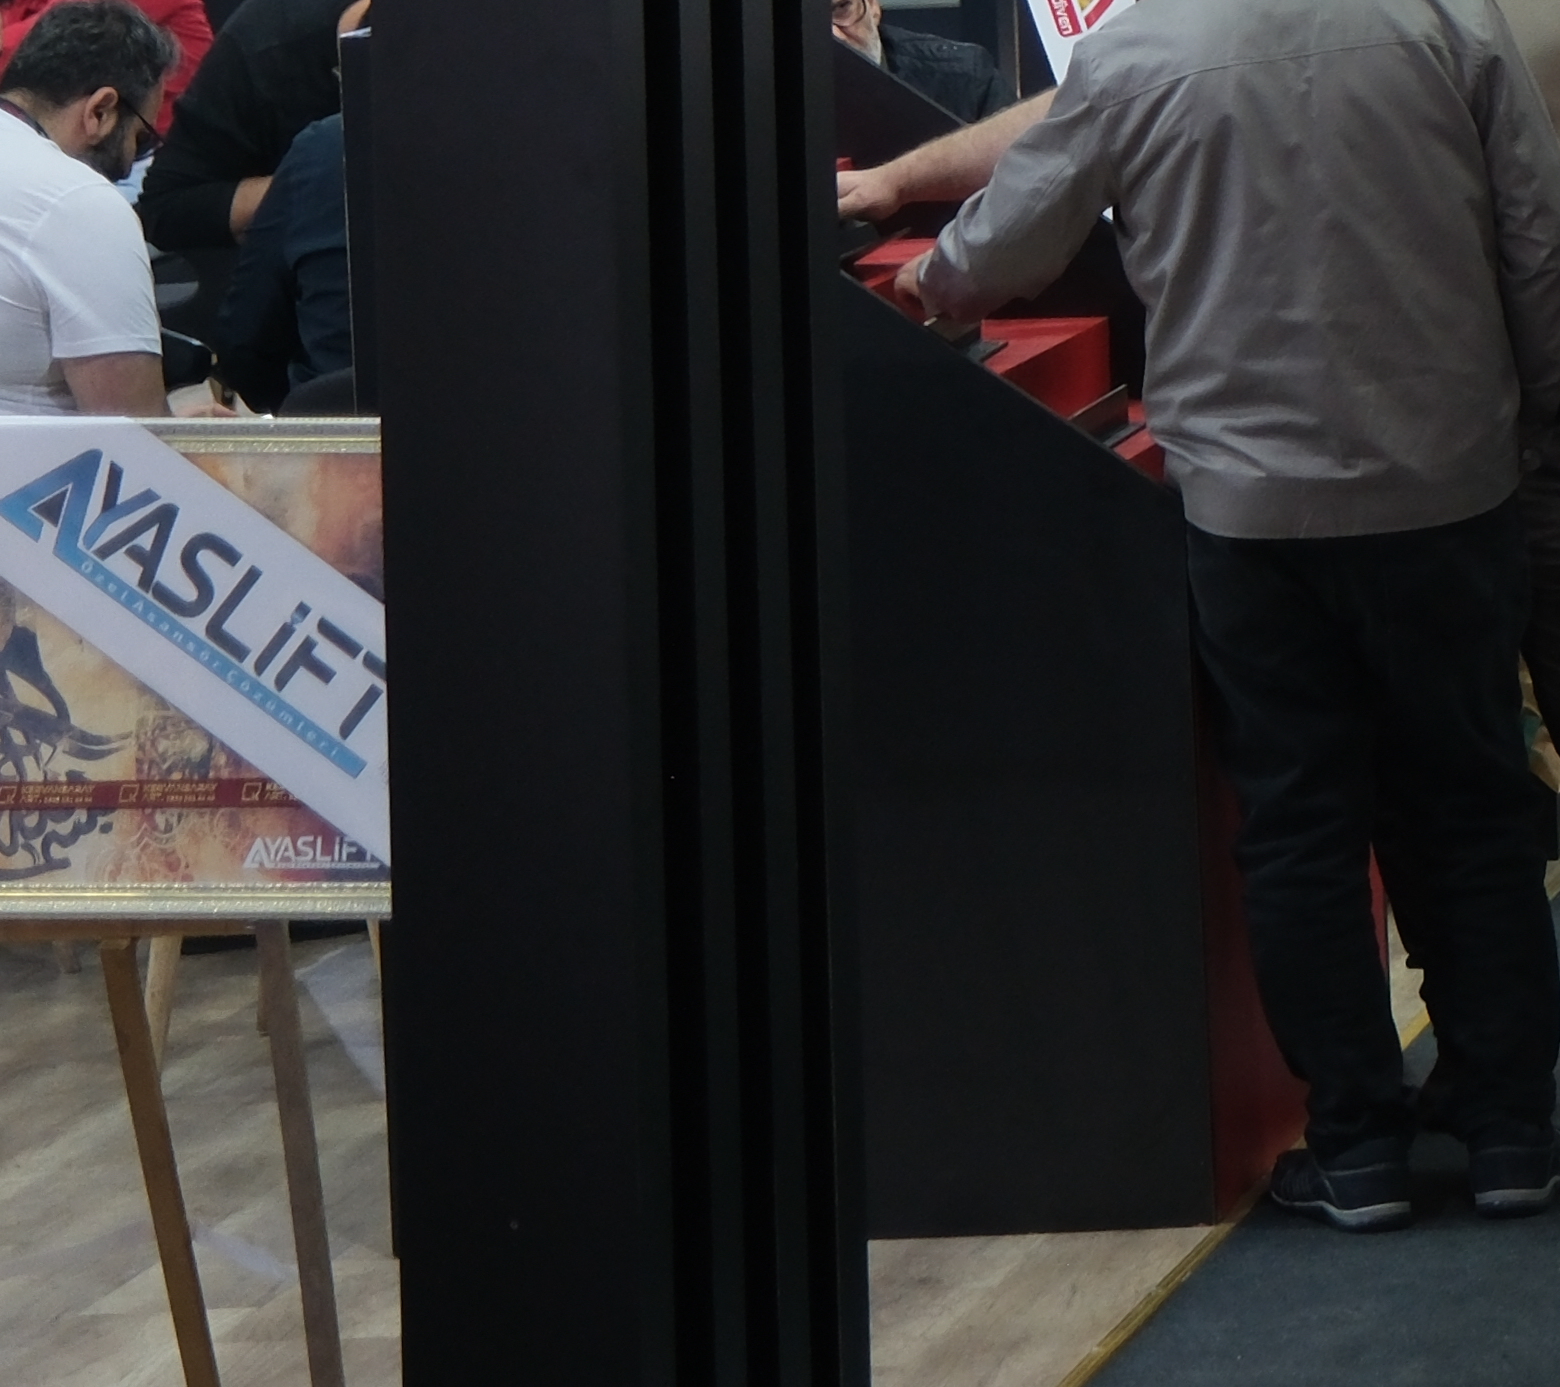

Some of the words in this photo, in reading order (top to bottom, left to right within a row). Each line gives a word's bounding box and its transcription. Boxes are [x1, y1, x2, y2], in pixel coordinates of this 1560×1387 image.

[82, 561, 128, 602] Özel
[133, 600, 221, 669] Asansör
[225, 671, 339, 760] Çözümleri
